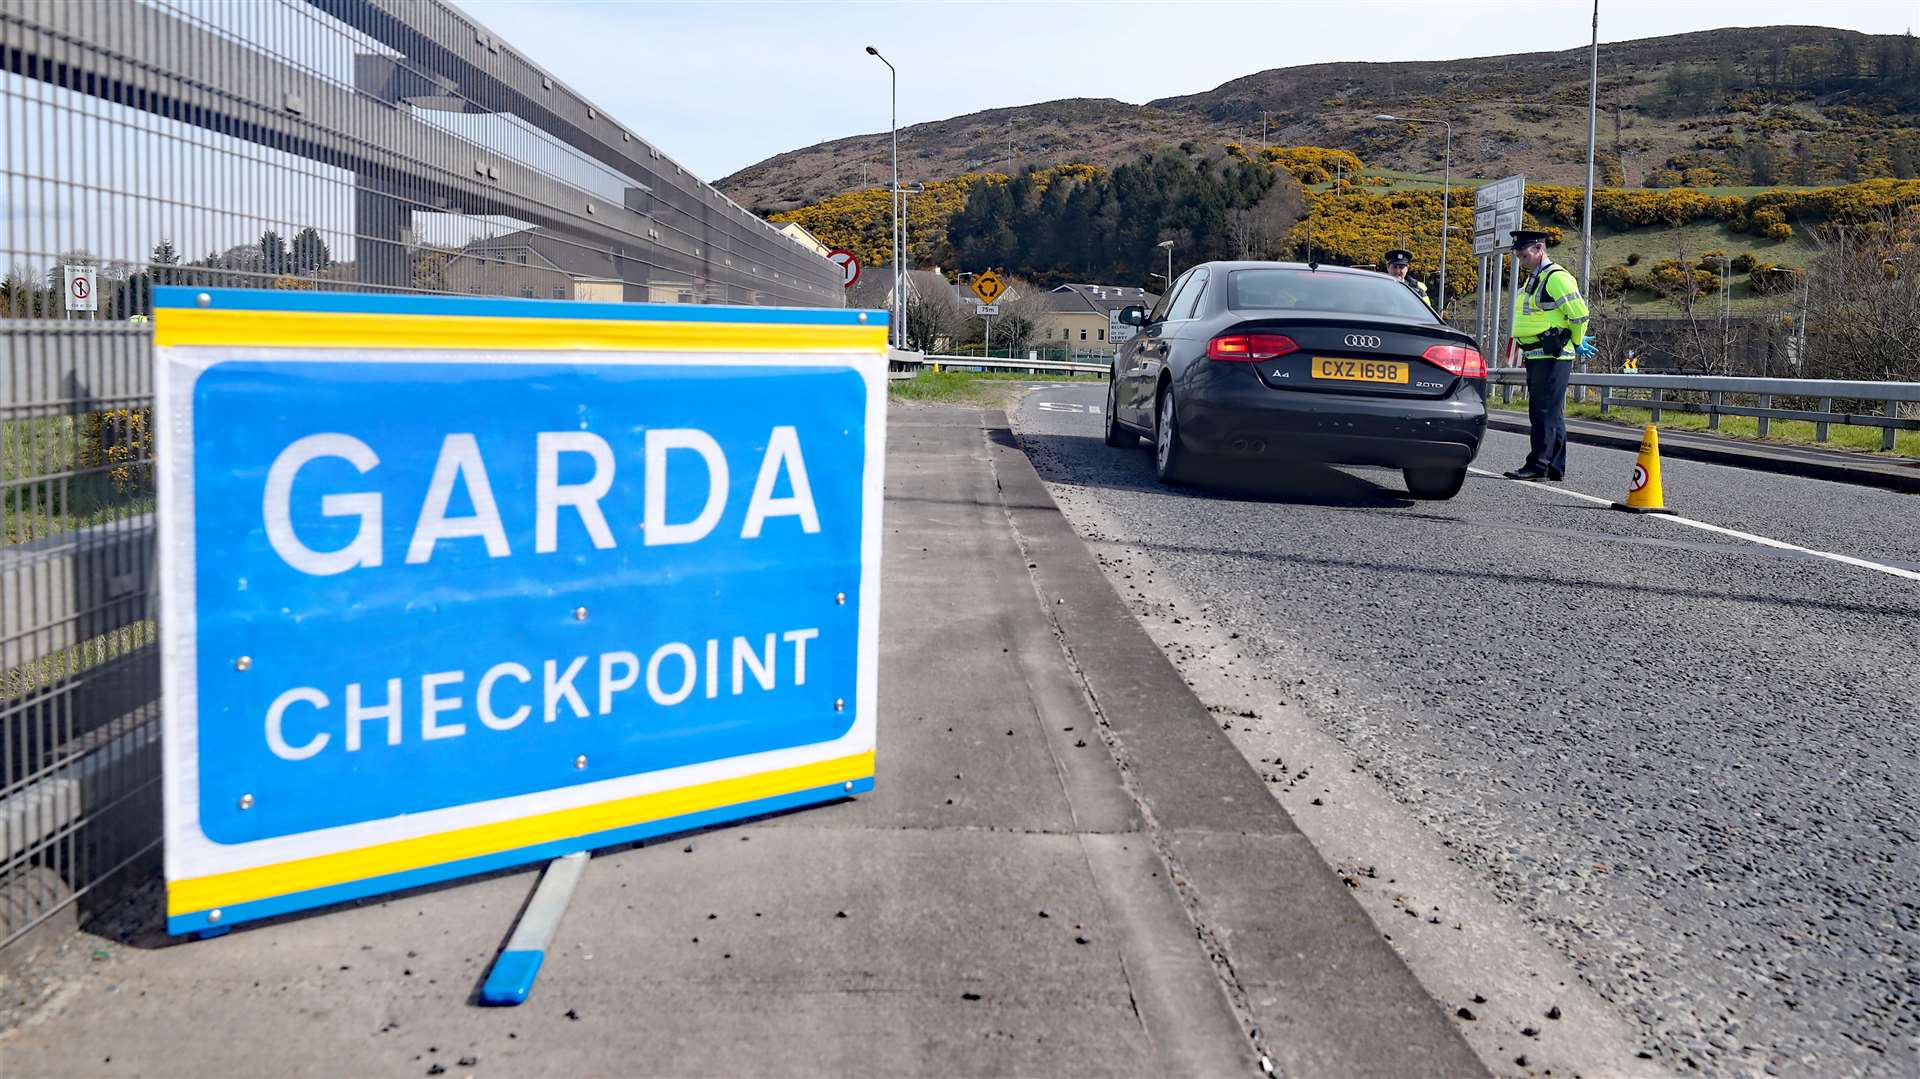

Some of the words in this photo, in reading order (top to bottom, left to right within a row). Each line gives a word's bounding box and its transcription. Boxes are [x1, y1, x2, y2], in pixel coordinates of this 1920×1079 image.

[1272, 369, 1290, 378] A4
[1322, 360, 1355, 378] CXZ
[1360, 362, 1398, 380] 1698
[263, 425, 821, 576] GARDA
[264, 628, 819, 762] CHECKPOINT
